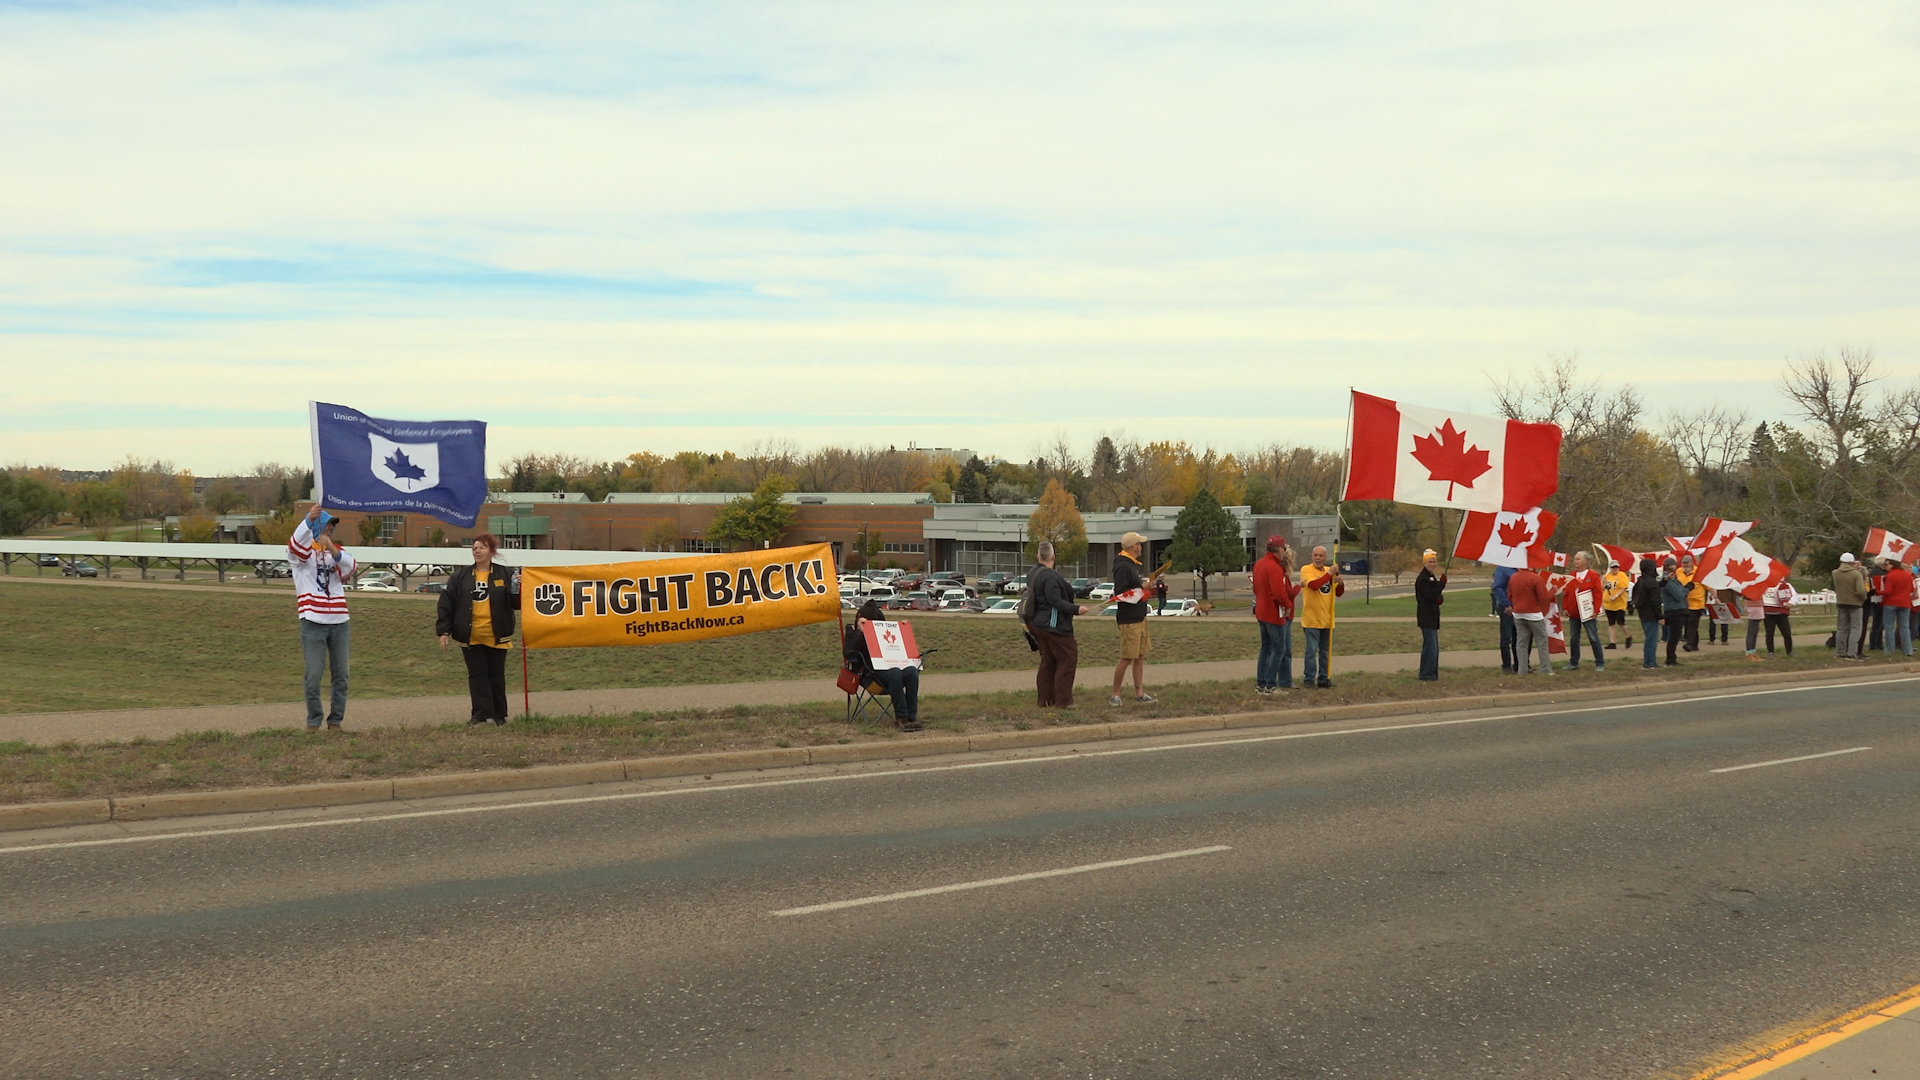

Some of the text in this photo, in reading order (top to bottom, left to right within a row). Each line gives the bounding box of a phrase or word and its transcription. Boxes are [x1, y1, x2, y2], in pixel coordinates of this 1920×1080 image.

[333, 412, 358, 421] Union
[327, 494, 347, 505] Union
[364, 499, 403, 507] employés
[415, 500, 422, 508] la
[572, 558, 827, 617] FIGHT BACK!
[625, 615, 744, 637] FightBackNow.ca
